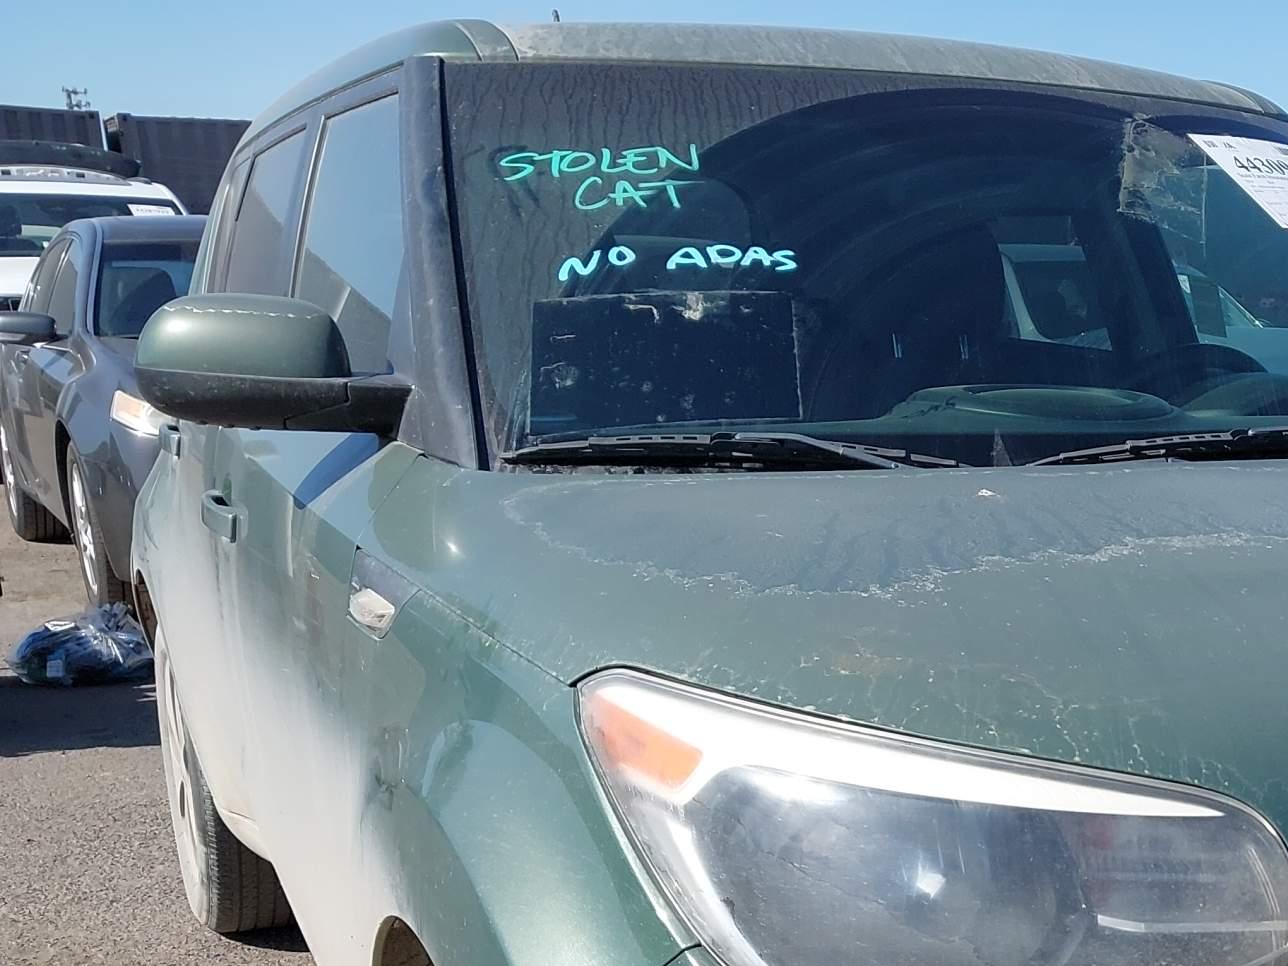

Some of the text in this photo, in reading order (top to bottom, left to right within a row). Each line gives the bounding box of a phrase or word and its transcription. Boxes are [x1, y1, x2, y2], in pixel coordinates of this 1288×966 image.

[500, 143, 699, 180] STOLEN
[575, 176, 704, 210] CAT
[558, 244, 798, 281] NO ADAS
